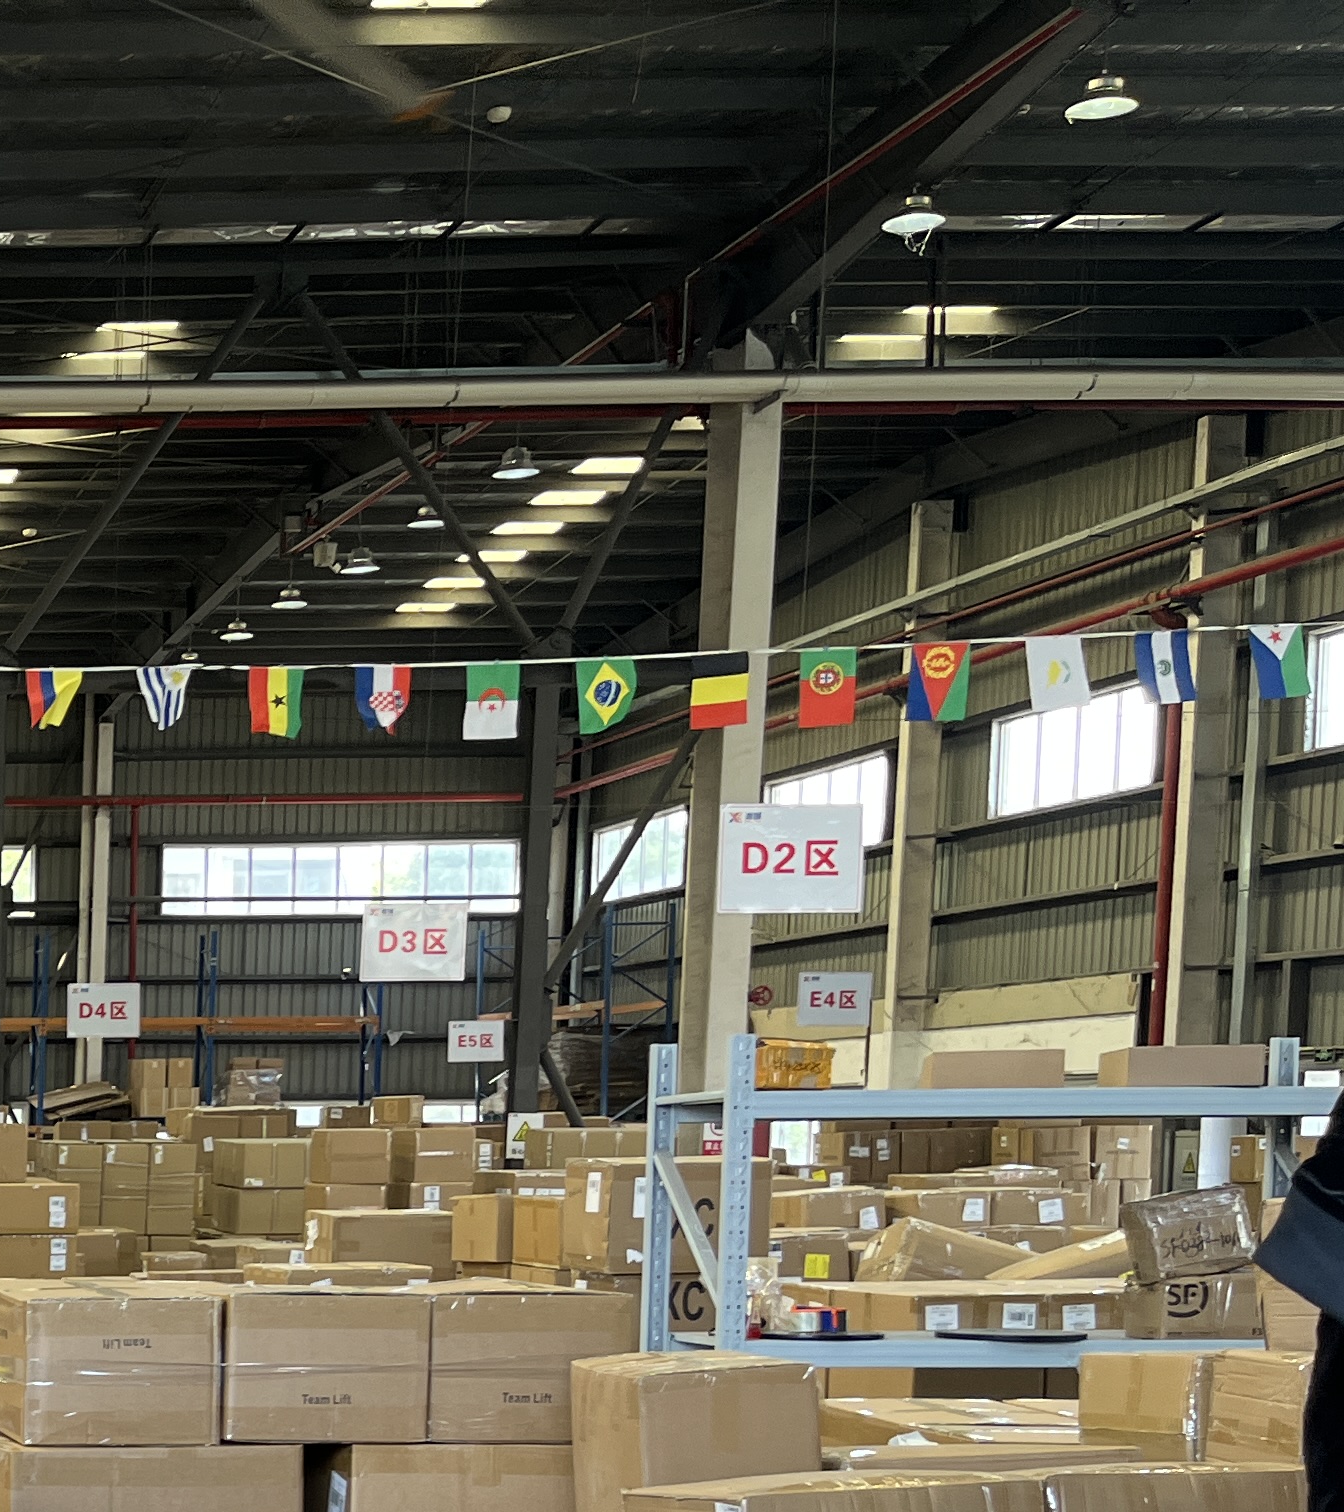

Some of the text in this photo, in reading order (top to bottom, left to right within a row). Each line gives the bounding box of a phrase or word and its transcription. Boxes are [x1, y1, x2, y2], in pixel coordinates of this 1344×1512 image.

[743, 840, 838, 875] D2区
[379, 928, 447, 954] D3区
[811, 991, 855, 1008] E4区
[80, 1002, 126, 1019] D4区
[458, 1034, 492, 1047] E5区
[102, 1338, 153, 1349] Team Lift
[301, 1393, 352, 1404] Team Lift
[502, 1392, 553, 1404] Team Lift
